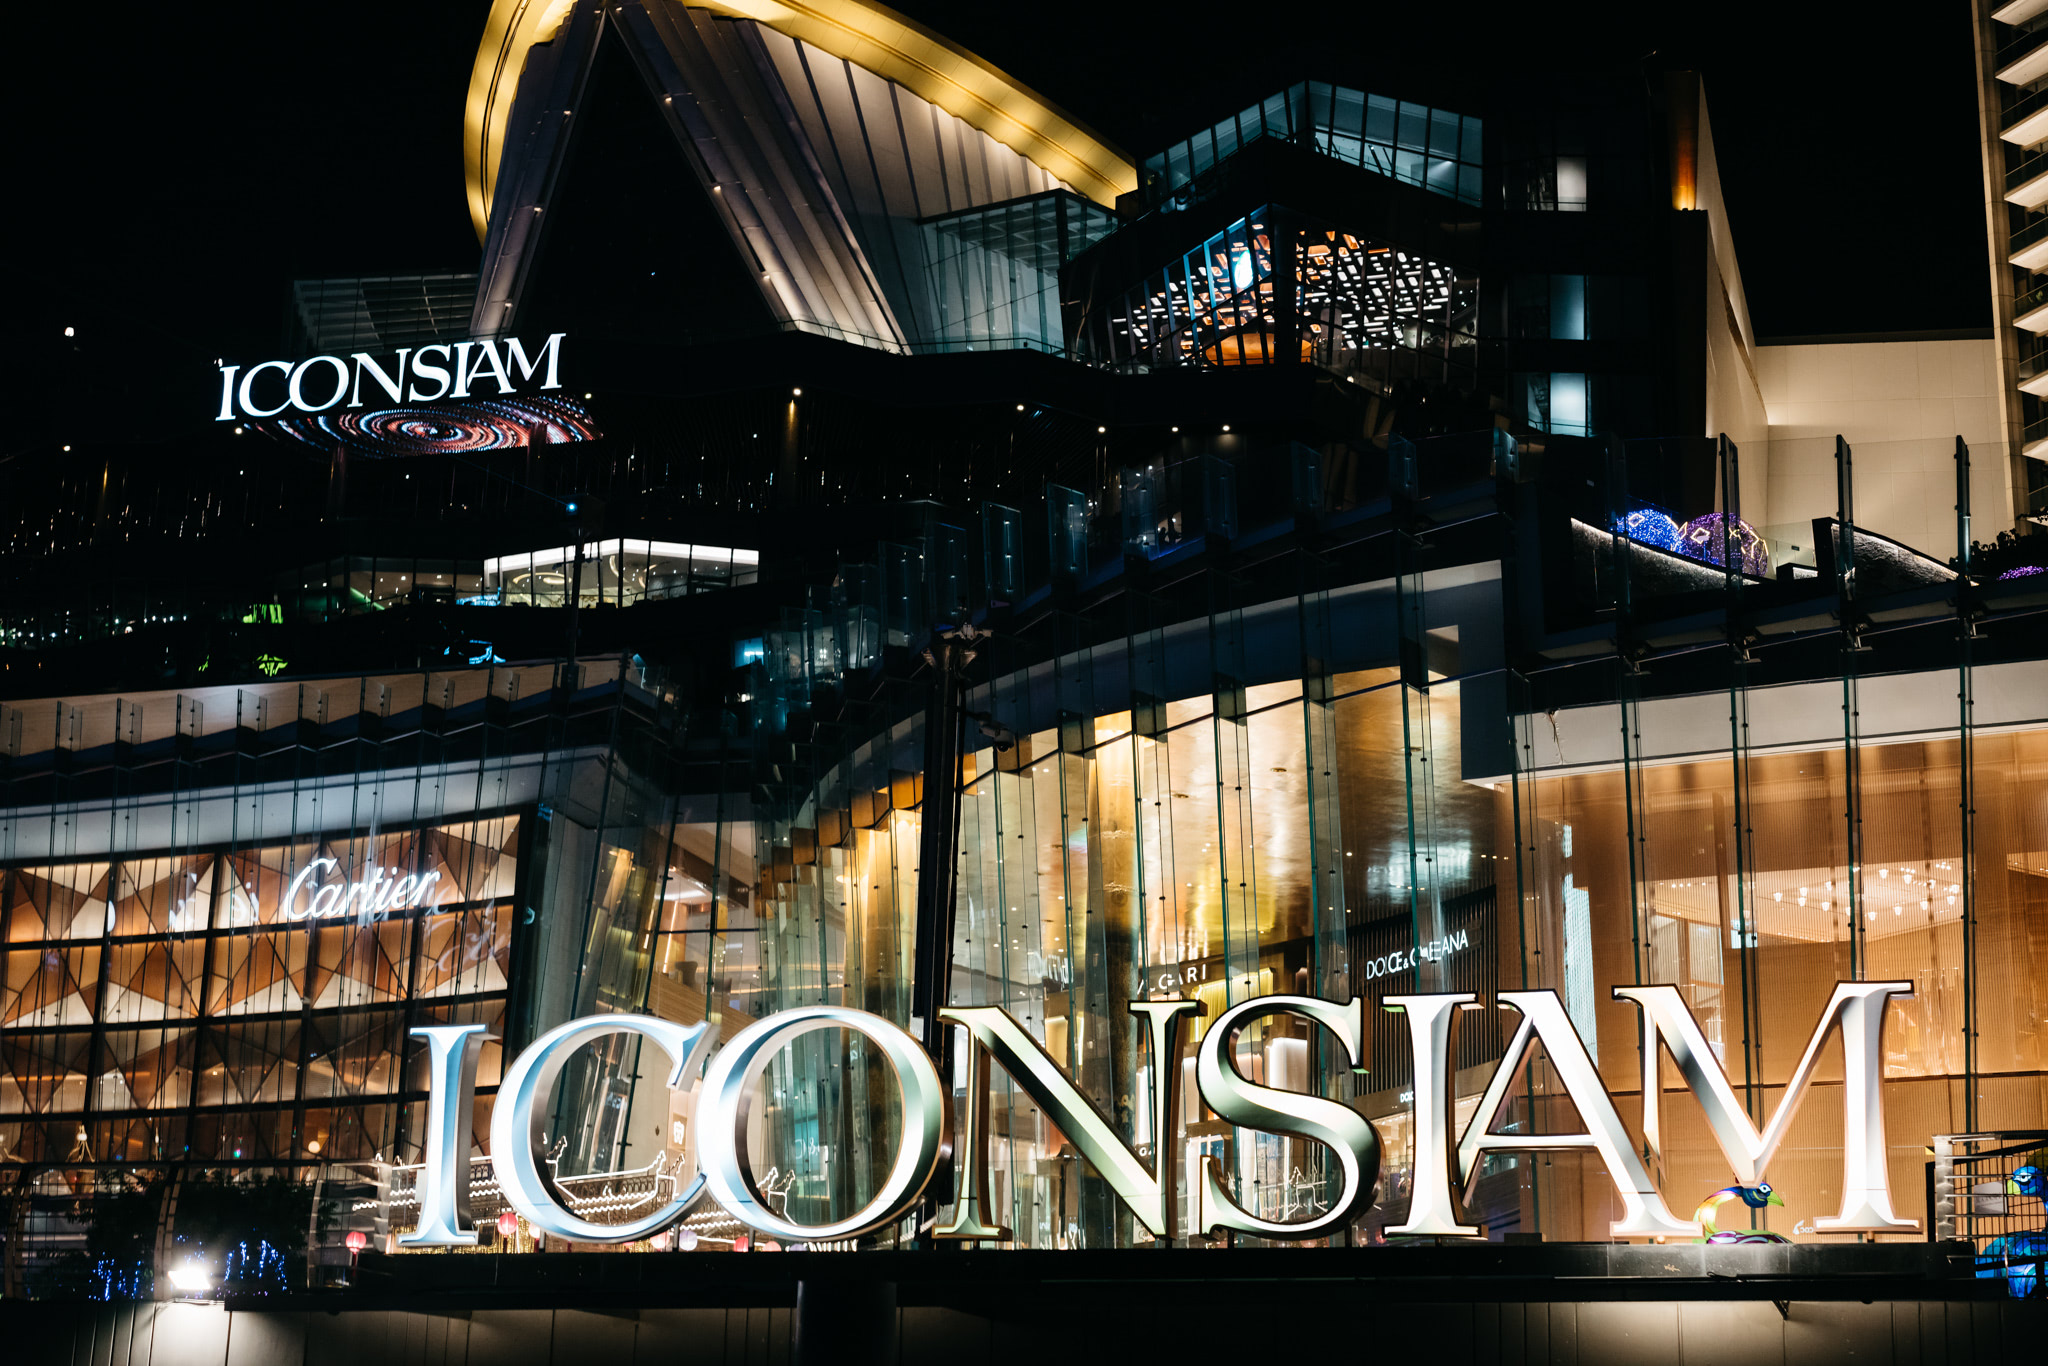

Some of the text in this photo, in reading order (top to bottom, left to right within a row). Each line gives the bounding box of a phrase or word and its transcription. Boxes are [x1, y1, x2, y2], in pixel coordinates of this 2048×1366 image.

[215, 333, 566, 421] ICONSIAM
[283, 858, 441, 920] Cartier
[400, 981, 1921, 1247] ICONSIAM
